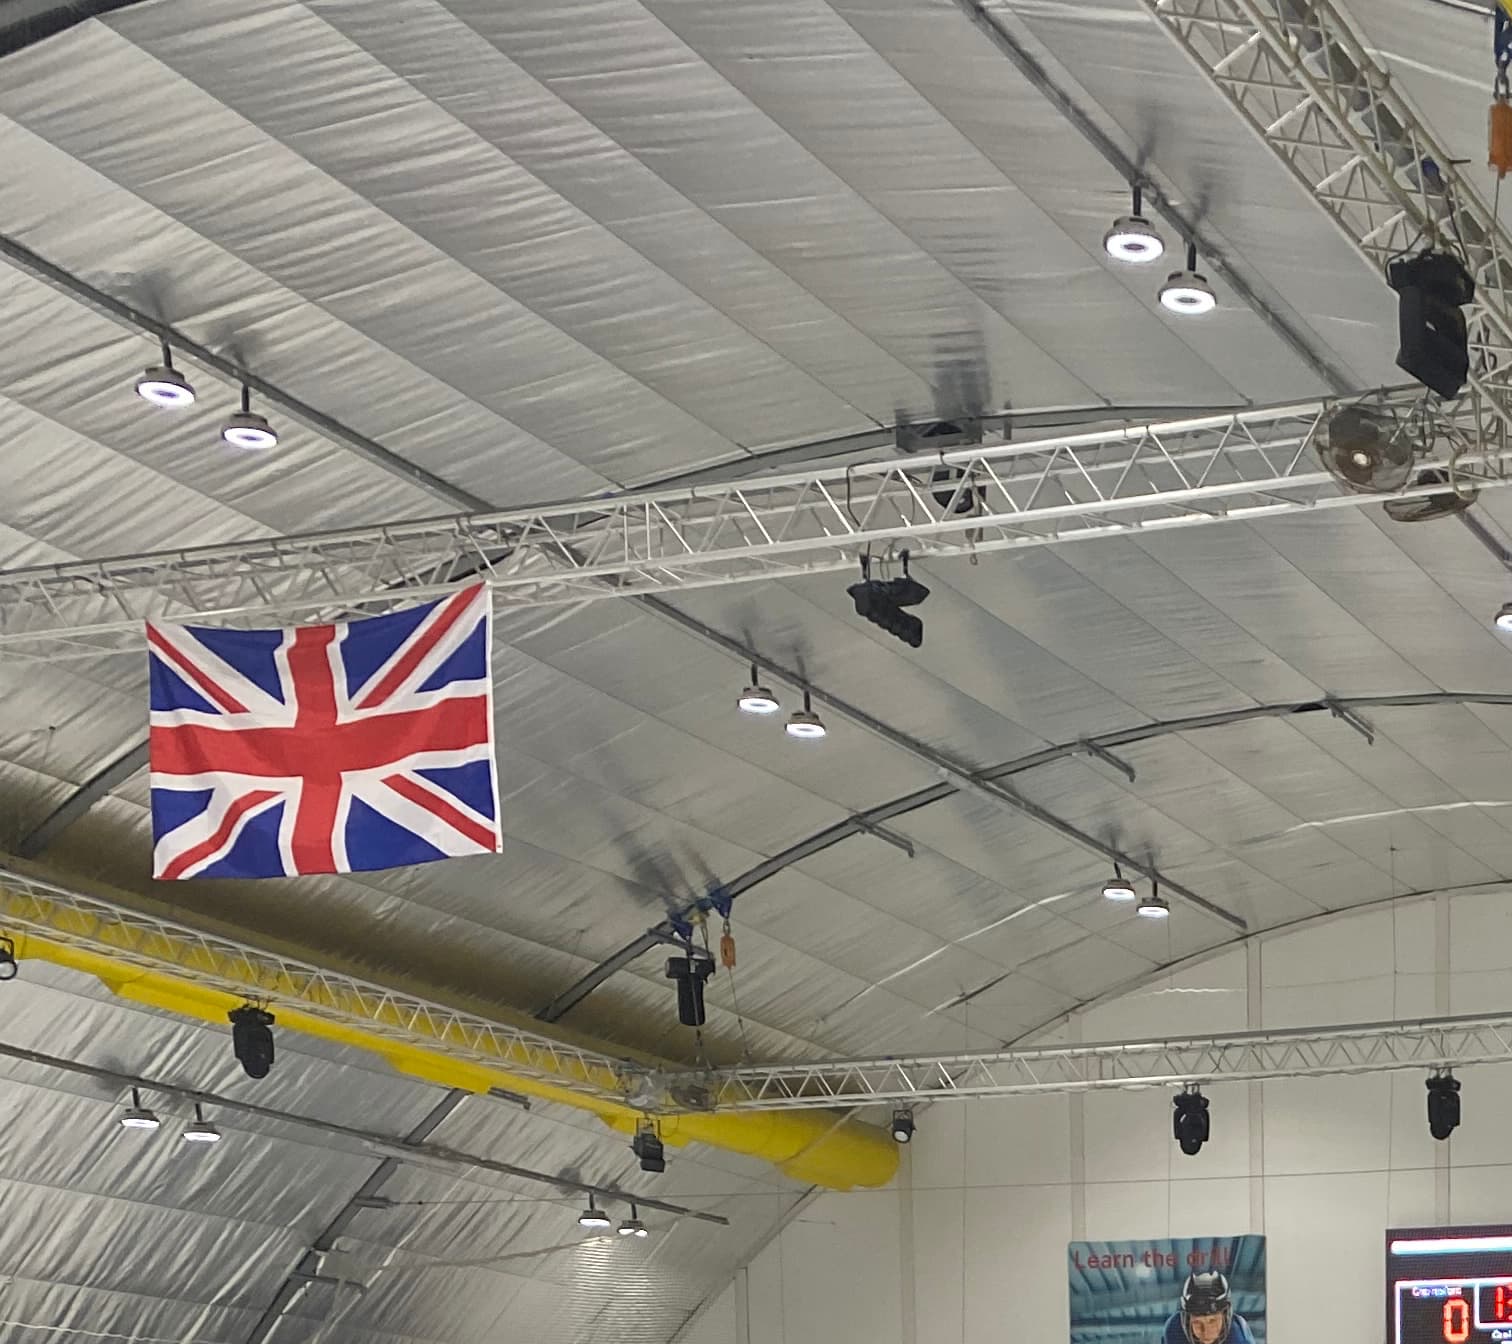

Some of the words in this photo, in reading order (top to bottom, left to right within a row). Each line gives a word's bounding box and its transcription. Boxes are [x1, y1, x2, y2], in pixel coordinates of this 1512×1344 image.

[1073, 1250, 1135, 1270] Learn
[1141, 1247, 1178, 1268] the
[1186, 1245, 1233, 1266] drill
[1443, 1298, 1470, 1344] 0
